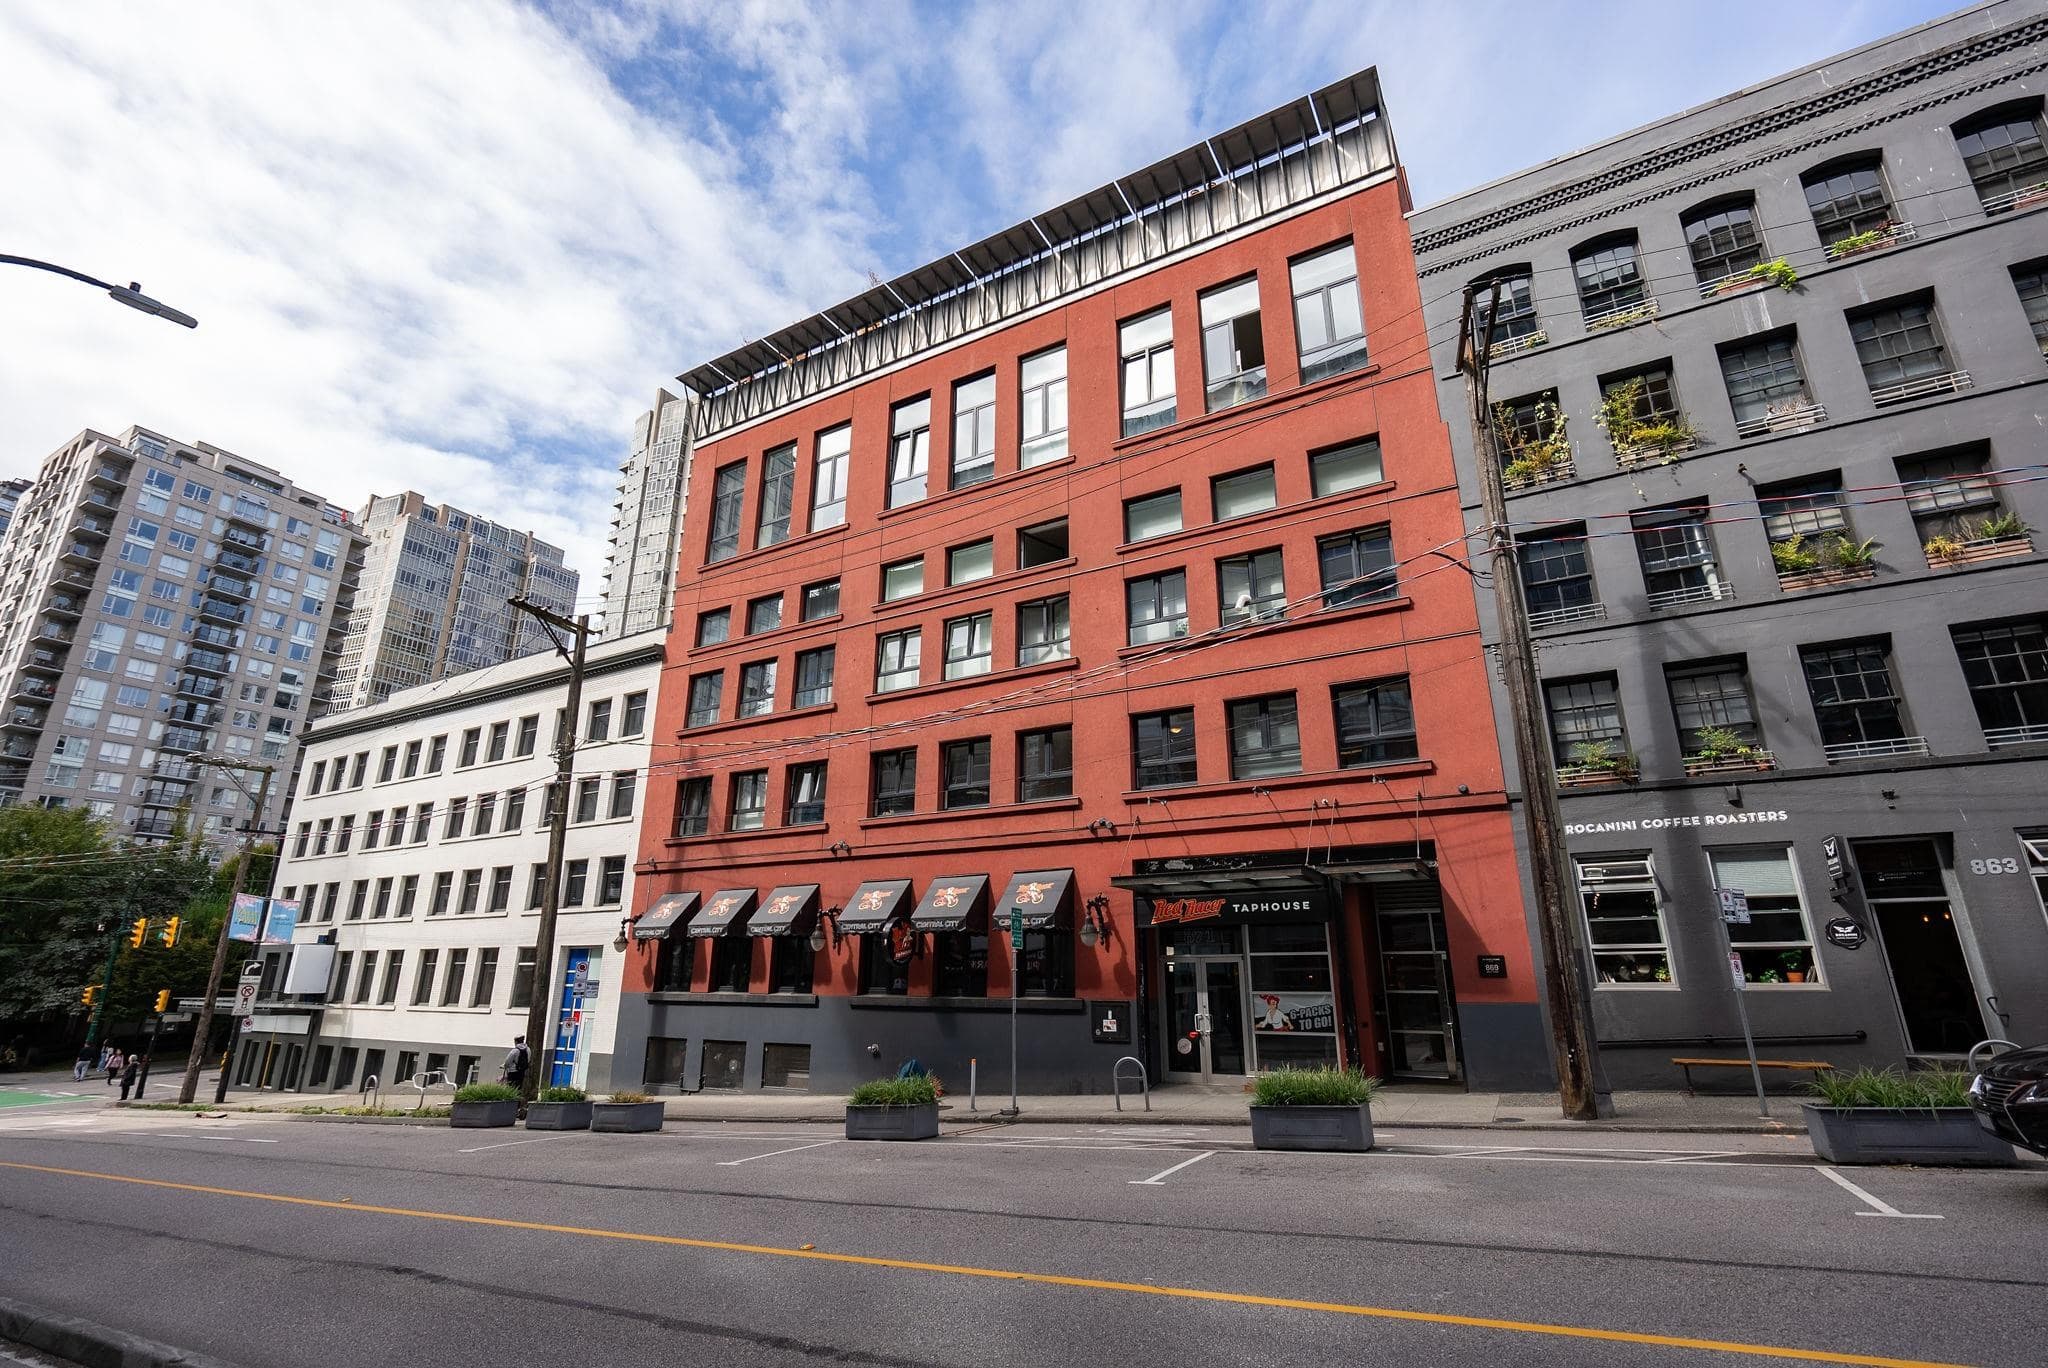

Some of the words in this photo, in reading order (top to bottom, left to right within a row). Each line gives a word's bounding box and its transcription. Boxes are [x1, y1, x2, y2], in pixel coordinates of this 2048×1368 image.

[1565, 820, 1638, 836] ROCANINI
[1641, 816, 1701, 830] COFFEE
[1705, 810, 1788, 825] ROASTERS
[1970, 858, 2019, 875] 863
[1152, 899, 1184, 919] Red
[1184, 899, 1226, 919] Racer
[1233, 901, 1310, 913] TAPHOUSE
[1031, 917, 1047, 926] CITY
[1290, 1004, 1332, 1020] 6-PACKS
[1299, 1018, 1312, 1031] TO
[1314, 1016, 1332, 1029] GO!
